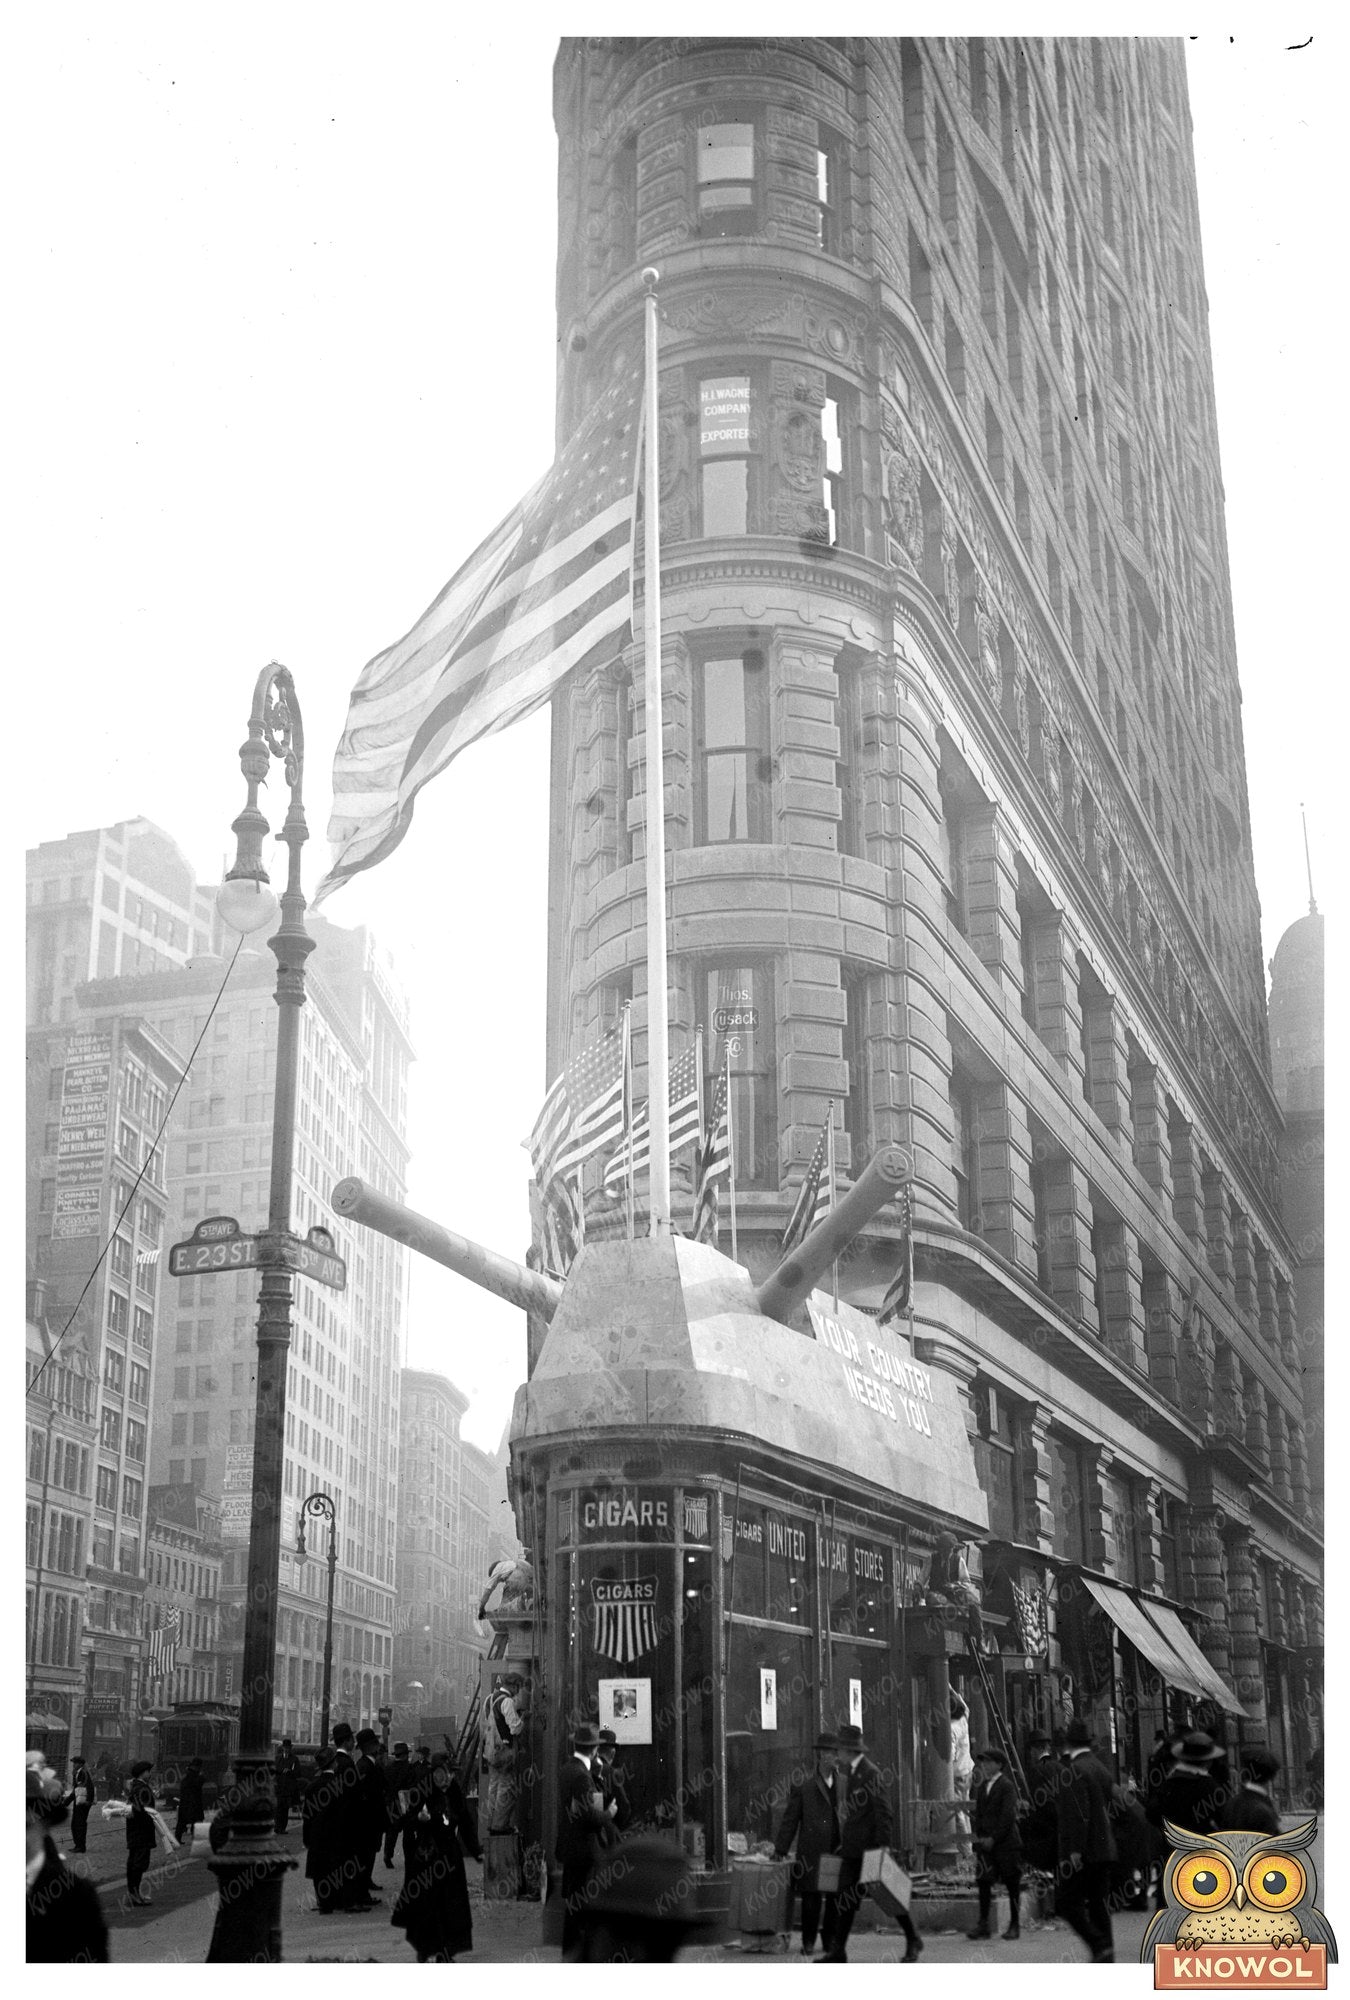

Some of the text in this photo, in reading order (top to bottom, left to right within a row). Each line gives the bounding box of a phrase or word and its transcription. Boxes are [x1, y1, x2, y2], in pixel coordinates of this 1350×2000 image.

[704, 403, 751, 416] COMPANY
[701, 428, 758, 443] EXPORTERS
[714, 1010, 758, 1031] Cusack
[729, 1036, 744, 1058] Co.
[64, 1103, 105, 1115] PAJAMAS
[62, 1111, 107, 1125] UNDERWEAR
[60, 1127, 106, 1143] HENRY WEIL
[58, 1190, 98, 1199] CORNELL
[58, 1197, 98, 1207] KNITTING
[200, 1223, 233, 1239] 5TH AVE
[175, 1241, 256, 1271] E. 23 ST.
[300, 1246, 342, 1285] 5TH AVE
[813, 1310, 934, 1404] YOUR COUNTRY
[842, 1363, 932, 1438] NEEDS YOU
[228, 1446, 253, 1454] FLOOR
[225, 1501, 252, 1509] FLOOR
[232, 1509, 252, 1517] LEAS
[585, 1500, 668, 1528] CIGARS
[736, 1519, 762, 1543] CIGARS
[769, 1521, 806, 1562] UNITED
[854, 1547, 883, 1582] STORES
[596, 1584, 654, 1599] CIGARS
